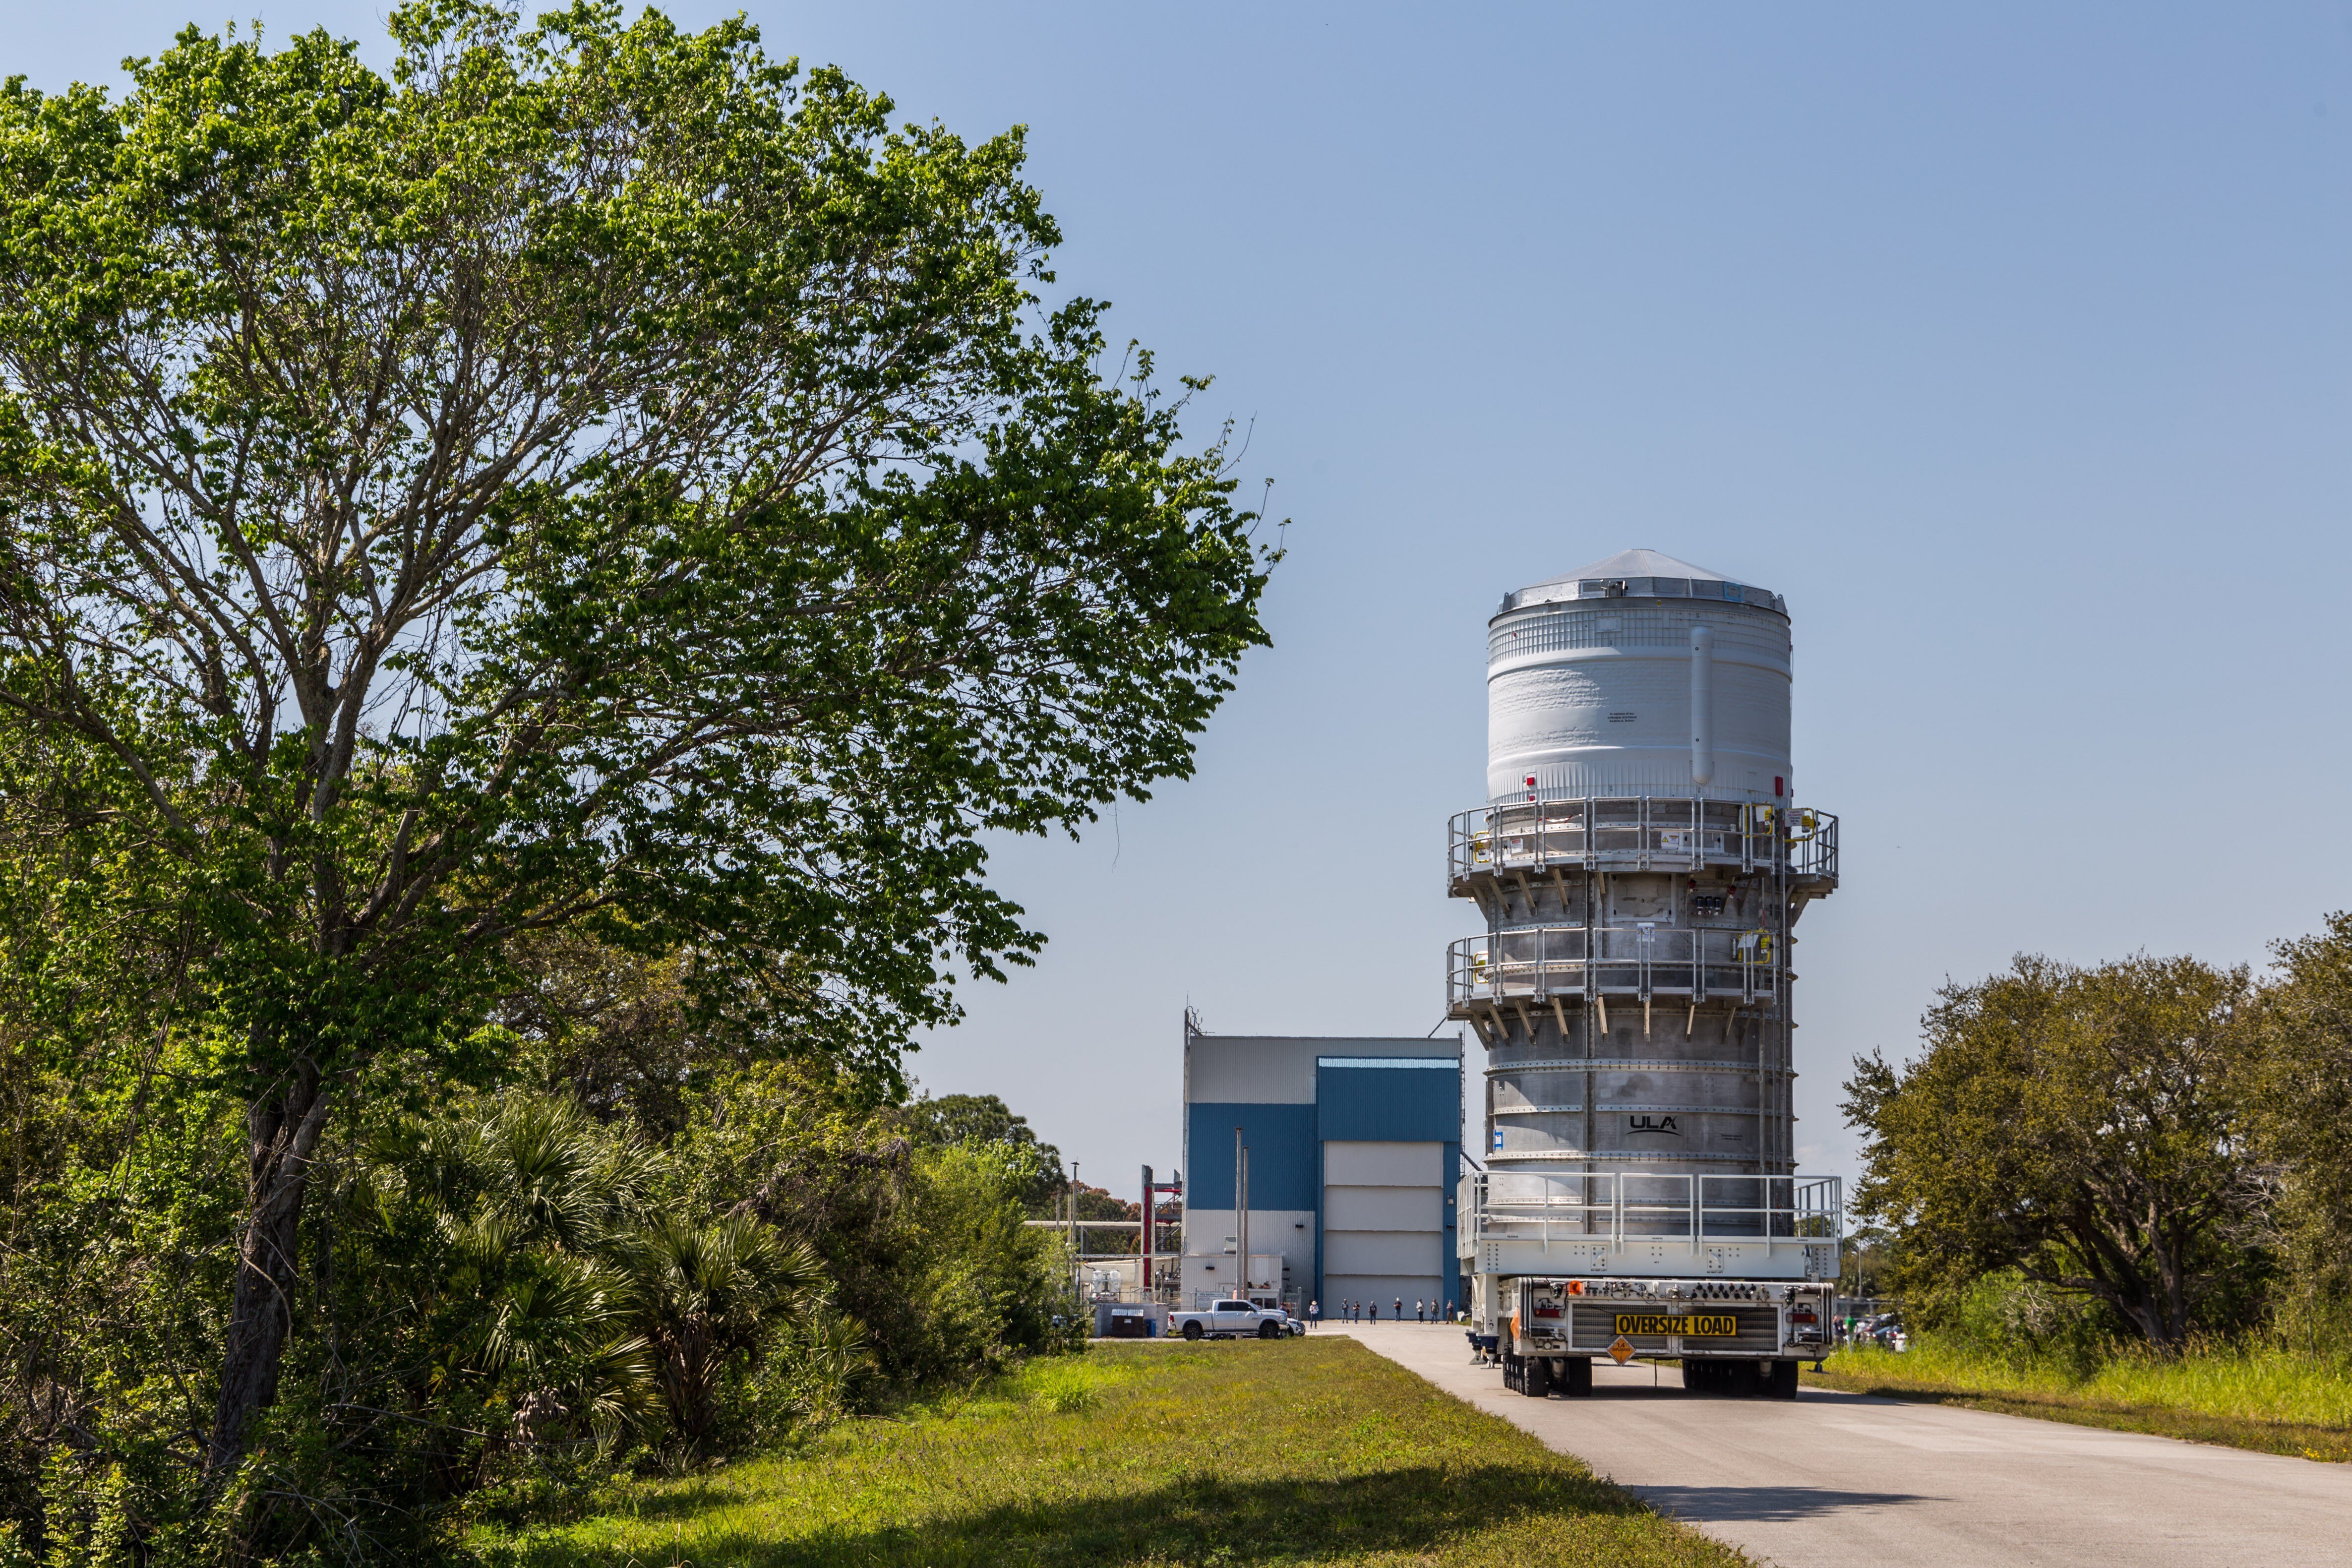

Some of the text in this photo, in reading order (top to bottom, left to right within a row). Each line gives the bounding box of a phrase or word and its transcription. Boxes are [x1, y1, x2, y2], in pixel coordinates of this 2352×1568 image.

[1630, 1115, 1677, 1129] ULA
[1619, 1316, 1734, 1334] OVERSIZE LOAD
